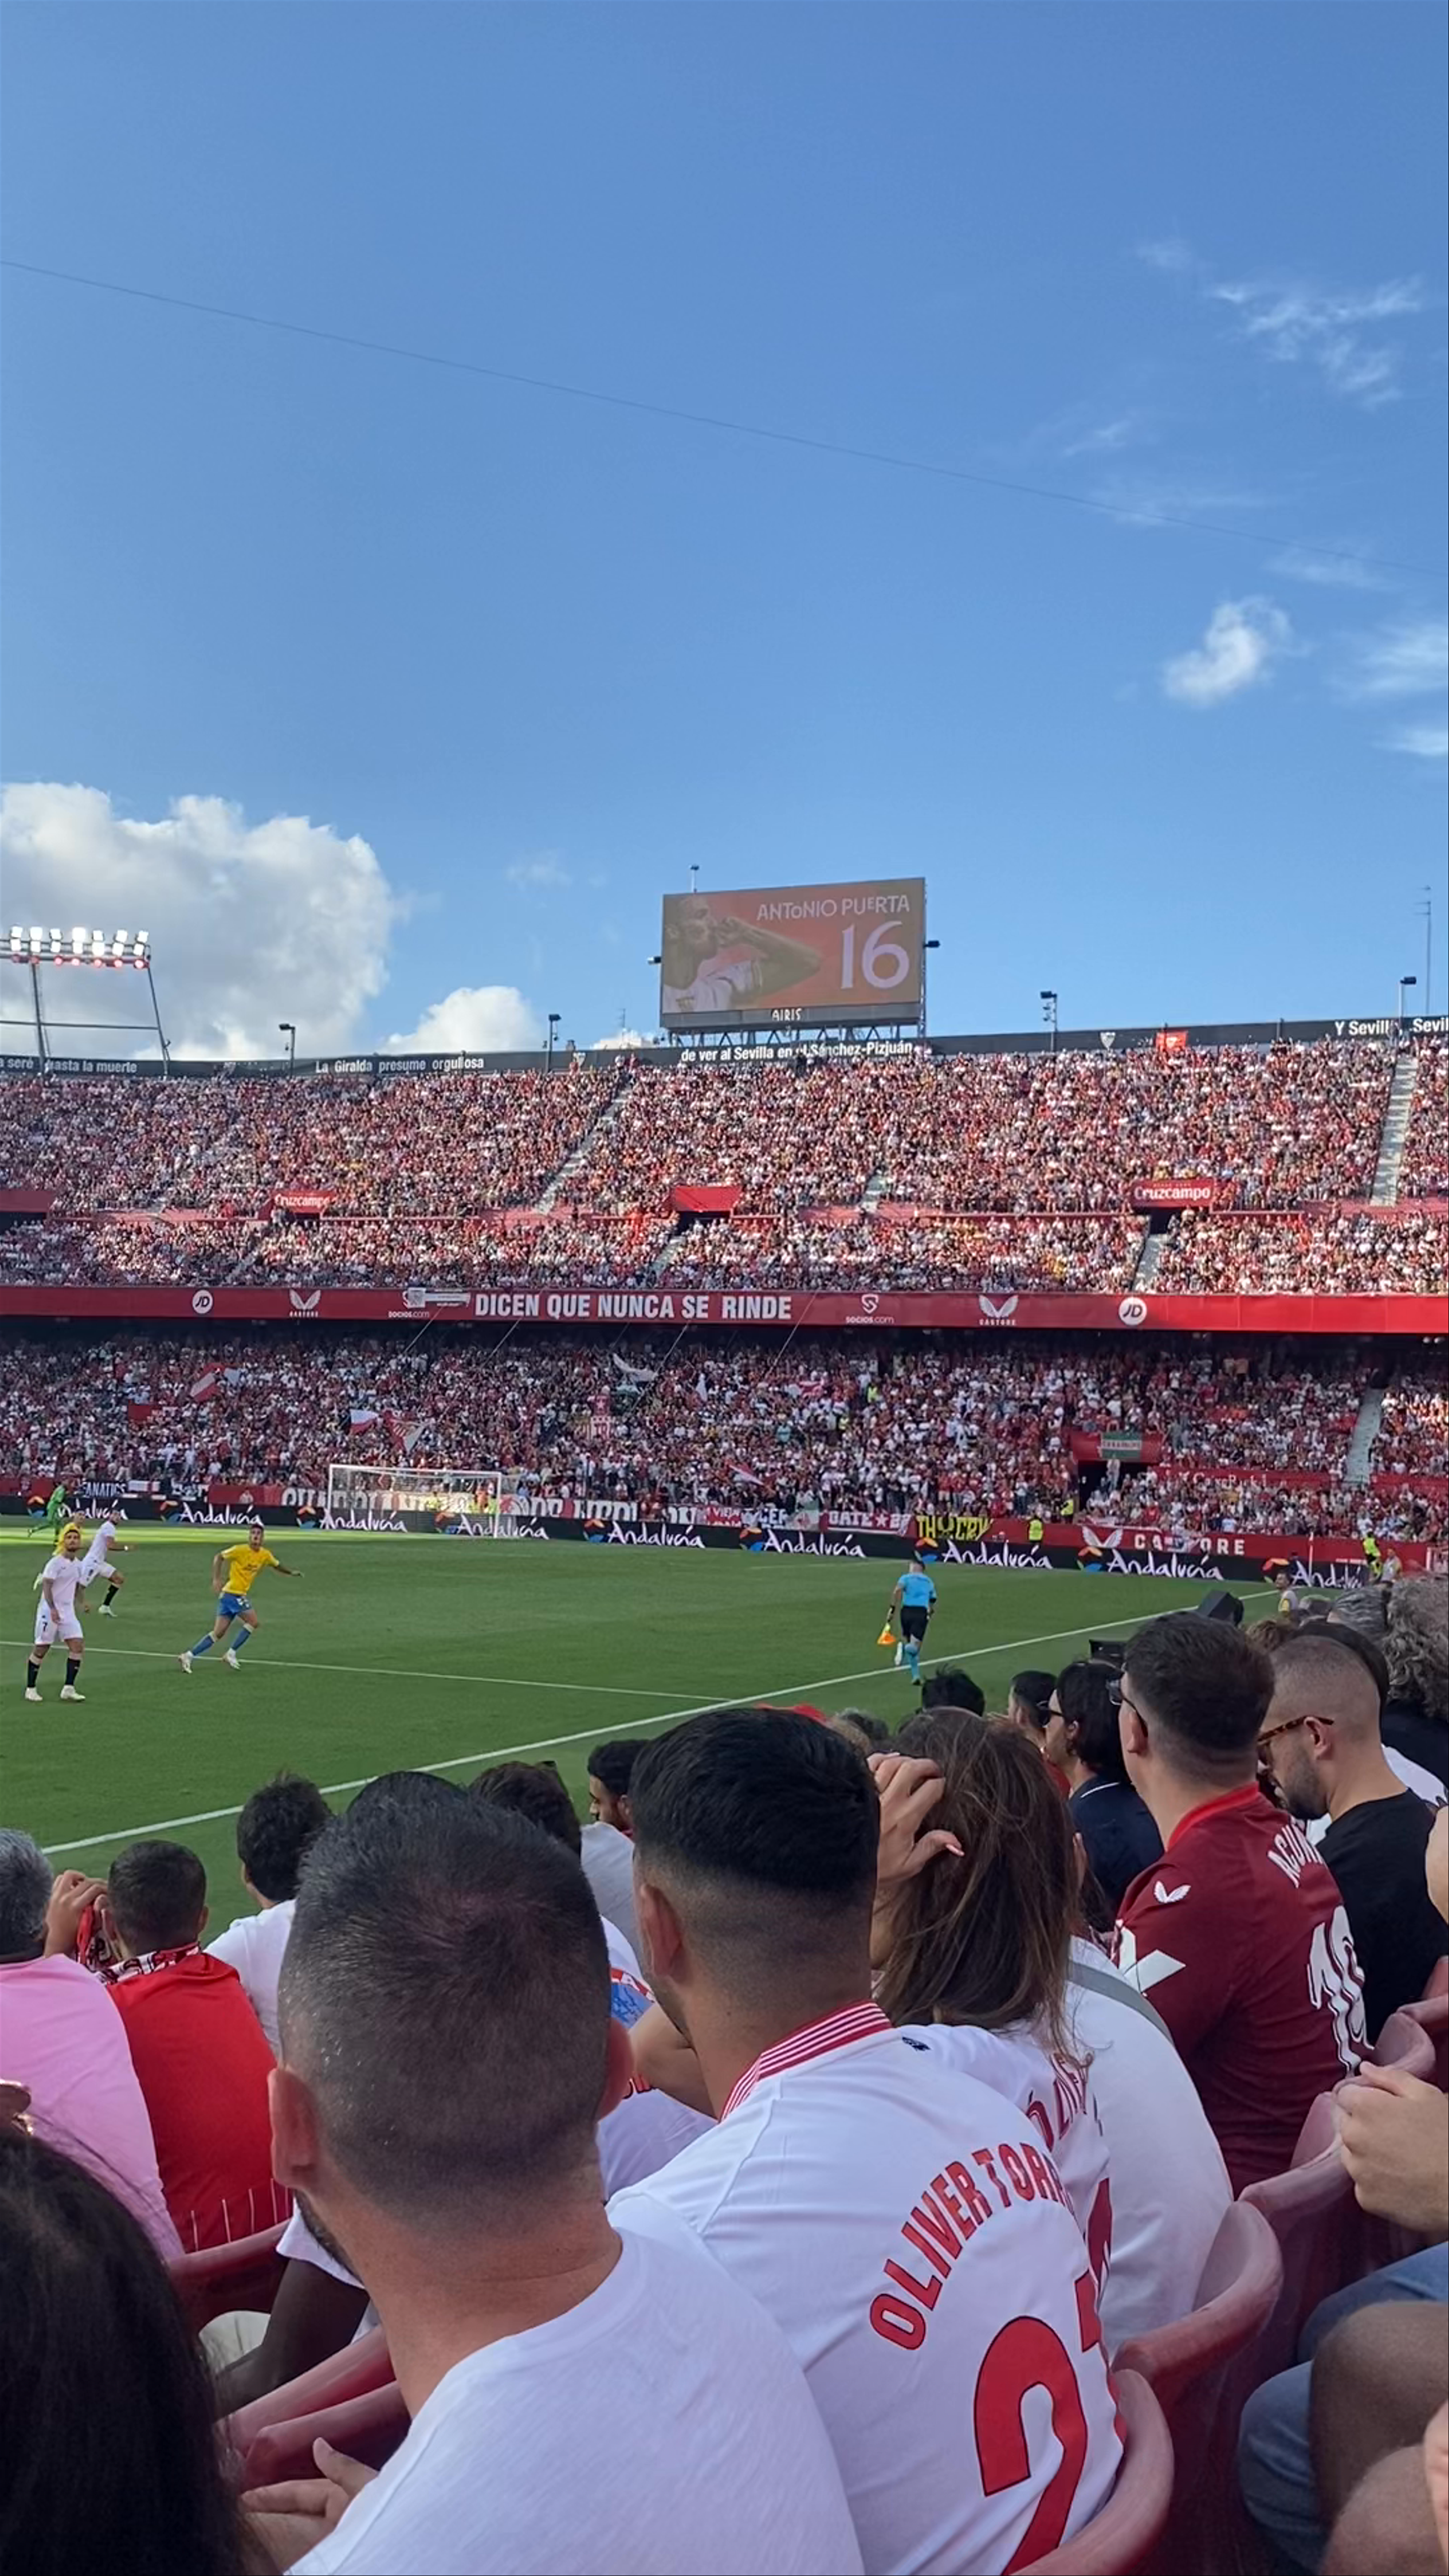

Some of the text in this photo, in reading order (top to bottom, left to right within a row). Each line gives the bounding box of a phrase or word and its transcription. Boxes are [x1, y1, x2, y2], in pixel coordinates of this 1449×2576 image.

[756, 894, 910, 920] ANTONIO PUERTA
[841, 921, 910, 989] 16
[772, 1007, 802, 1021] AIRIS
[1335, 1021, 1344, 1036] Y
[681, 1048, 695, 1062] de
[698, 1049, 718, 1061] ver
[720, 1046, 731, 1060] al
[734, 1044, 775, 1059] Sevilla
[777, 1047, 792, 1058] en
[96, 1061, 137, 1073] muerte
[315, 1057, 484, 1073] La Giralda presume orgullosa
[1134, 1186, 1211, 1201] Cruzcampo
[195, 1296, 210, 1308] JD
[475, 1293, 792, 1320] DICEN QUE NUNCA SE RINDE
[1123, 1304, 1143, 1318] JD
[319, 1508, 408, 1533] Andalucía
[607, 1519, 706, 1549] Andalucía
[763, 1527, 866, 1558] Andalucía
[941, 1538, 1054, 1569] Andalucía
[1106, 1547, 1224, 1581] Andalucía
